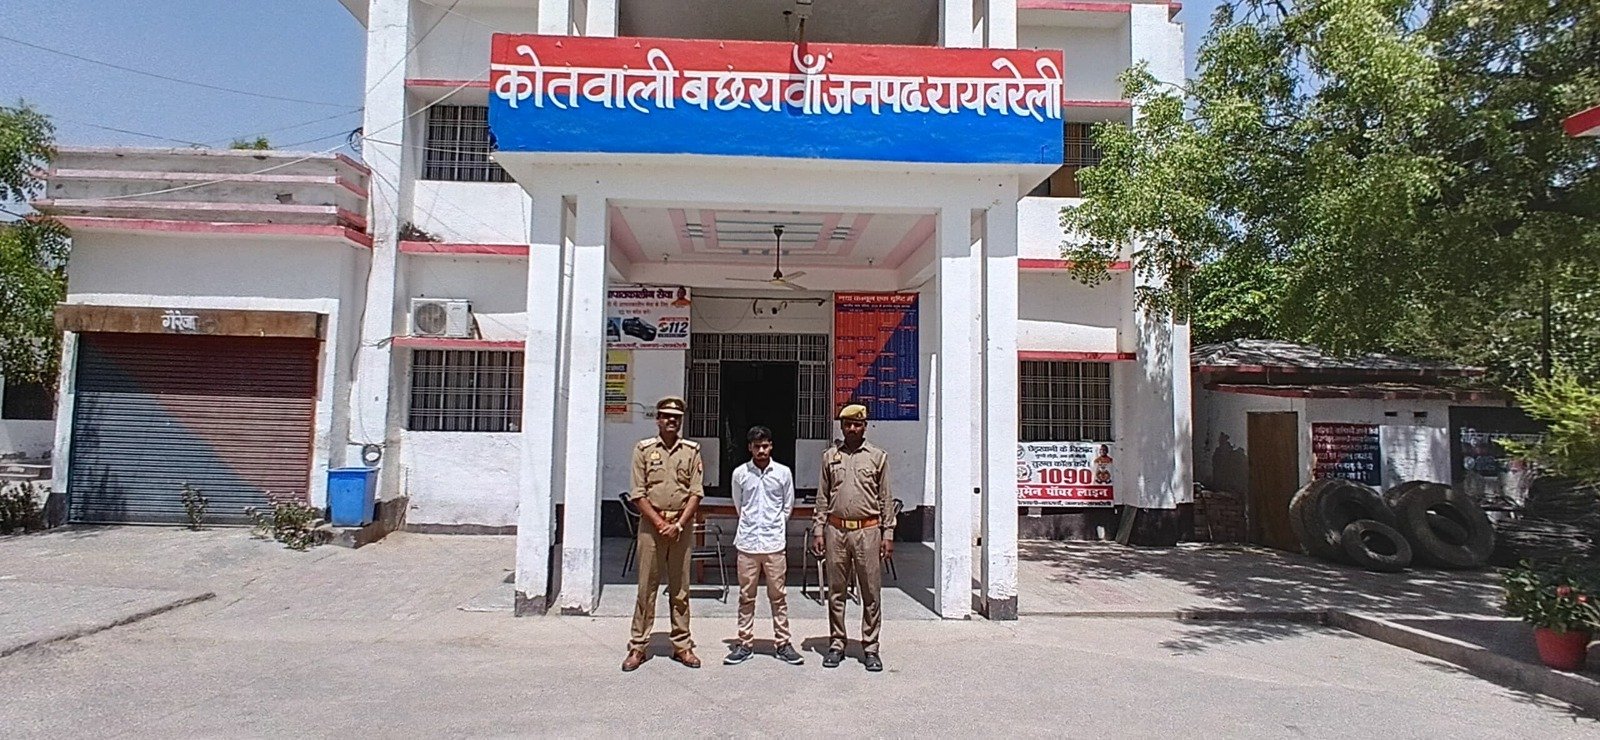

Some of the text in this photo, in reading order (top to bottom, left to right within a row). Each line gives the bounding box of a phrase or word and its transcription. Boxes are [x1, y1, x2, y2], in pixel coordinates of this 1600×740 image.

[491, 45, 680, 114] कोतवाली
[822, 74, 925, 116] जनपद
[925, 57, 1063, 122] रायबरेली
[669, 321, 688, 333] 112
[1037, 468, 1092, 485] 1090
[1046, 485, 1073, 497] पॉवर
[1075, 487, 1108, 497] लाइन
